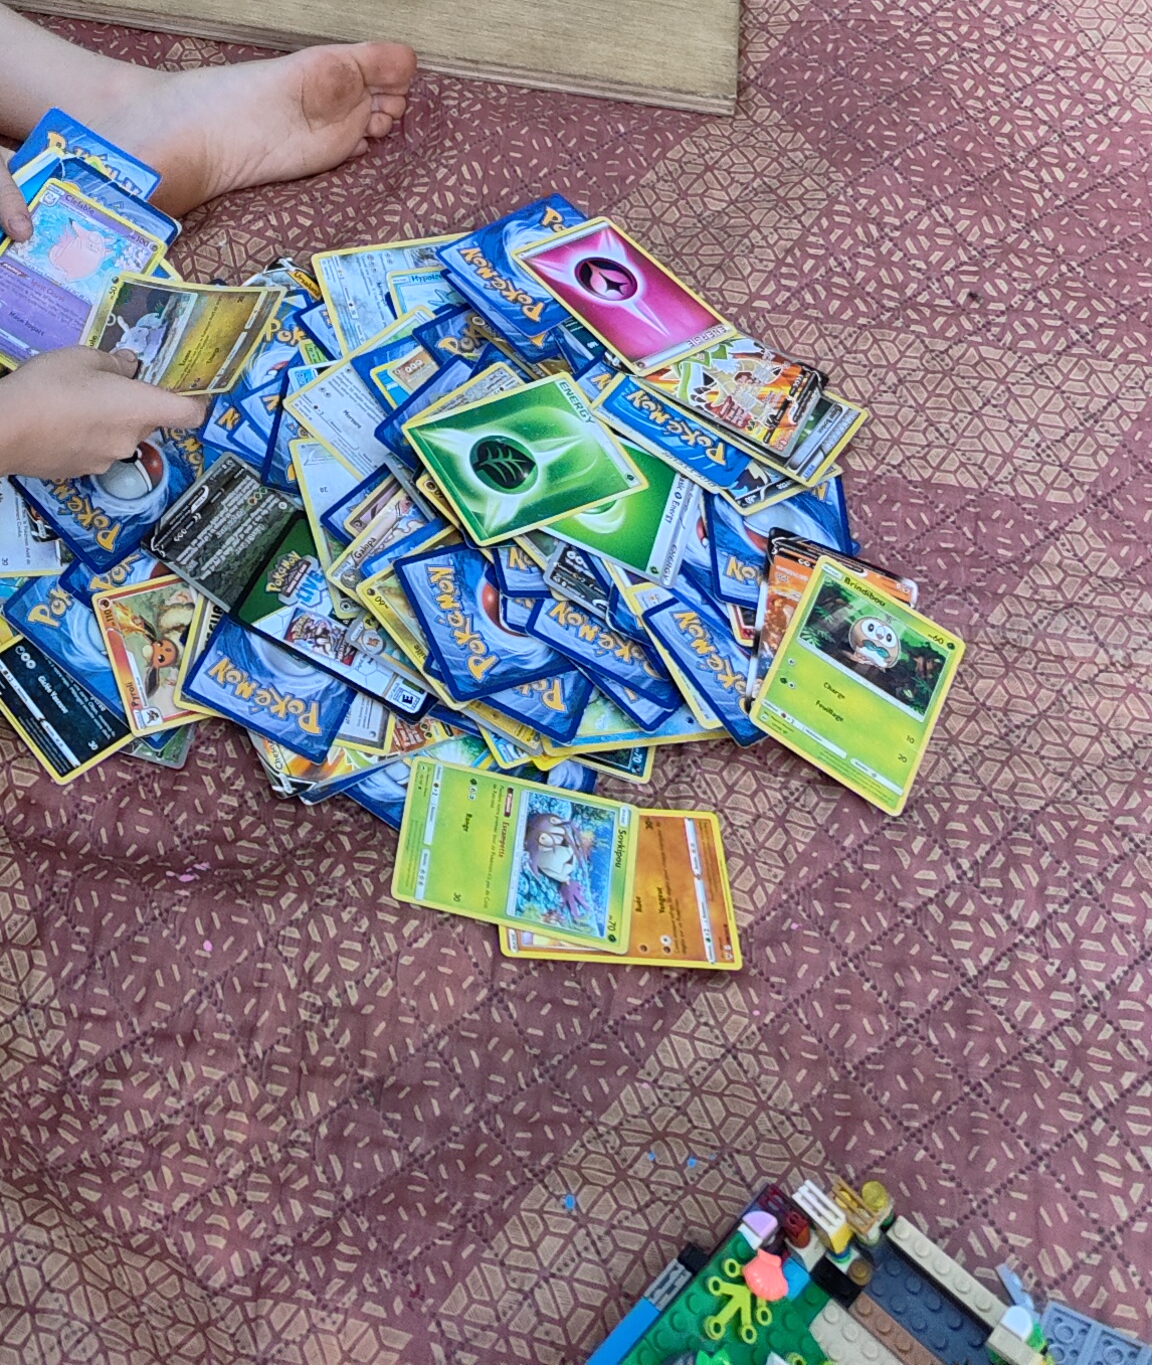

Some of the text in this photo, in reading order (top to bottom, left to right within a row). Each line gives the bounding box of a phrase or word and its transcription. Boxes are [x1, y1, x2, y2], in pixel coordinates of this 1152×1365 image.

[65, 194, 96, 216] Clefable
[458, 246, 545, 323] Pokémon
[686, 325, 729, 348] ENERGIE
[559, 381, 595, 424] ENERGY
[625, 389, 728, 467] Pokémon
[43, 475, 122, 554] Pokém
[665, 498, 681, 525] Energy
[353, 537, 377, 559] Galopa
[662, 543, 677, 581] ENERGY
[297, 568, 324, 602] LIVE
[843, 576, 887, 607] Brindibou
[425, 564, 503, 683] Pokémon
[547, 600, 665, 680] okémon
[126, 681, 139, 707] Pyroli
[208, 658, 322, 737] Pokémon
[823, 681, 846, 700] Charge
[815, 699, 844, 723] Feuillage
[497, 820, 511, 859] Escampette
[615, 829, 627, 869] Sovkipou
